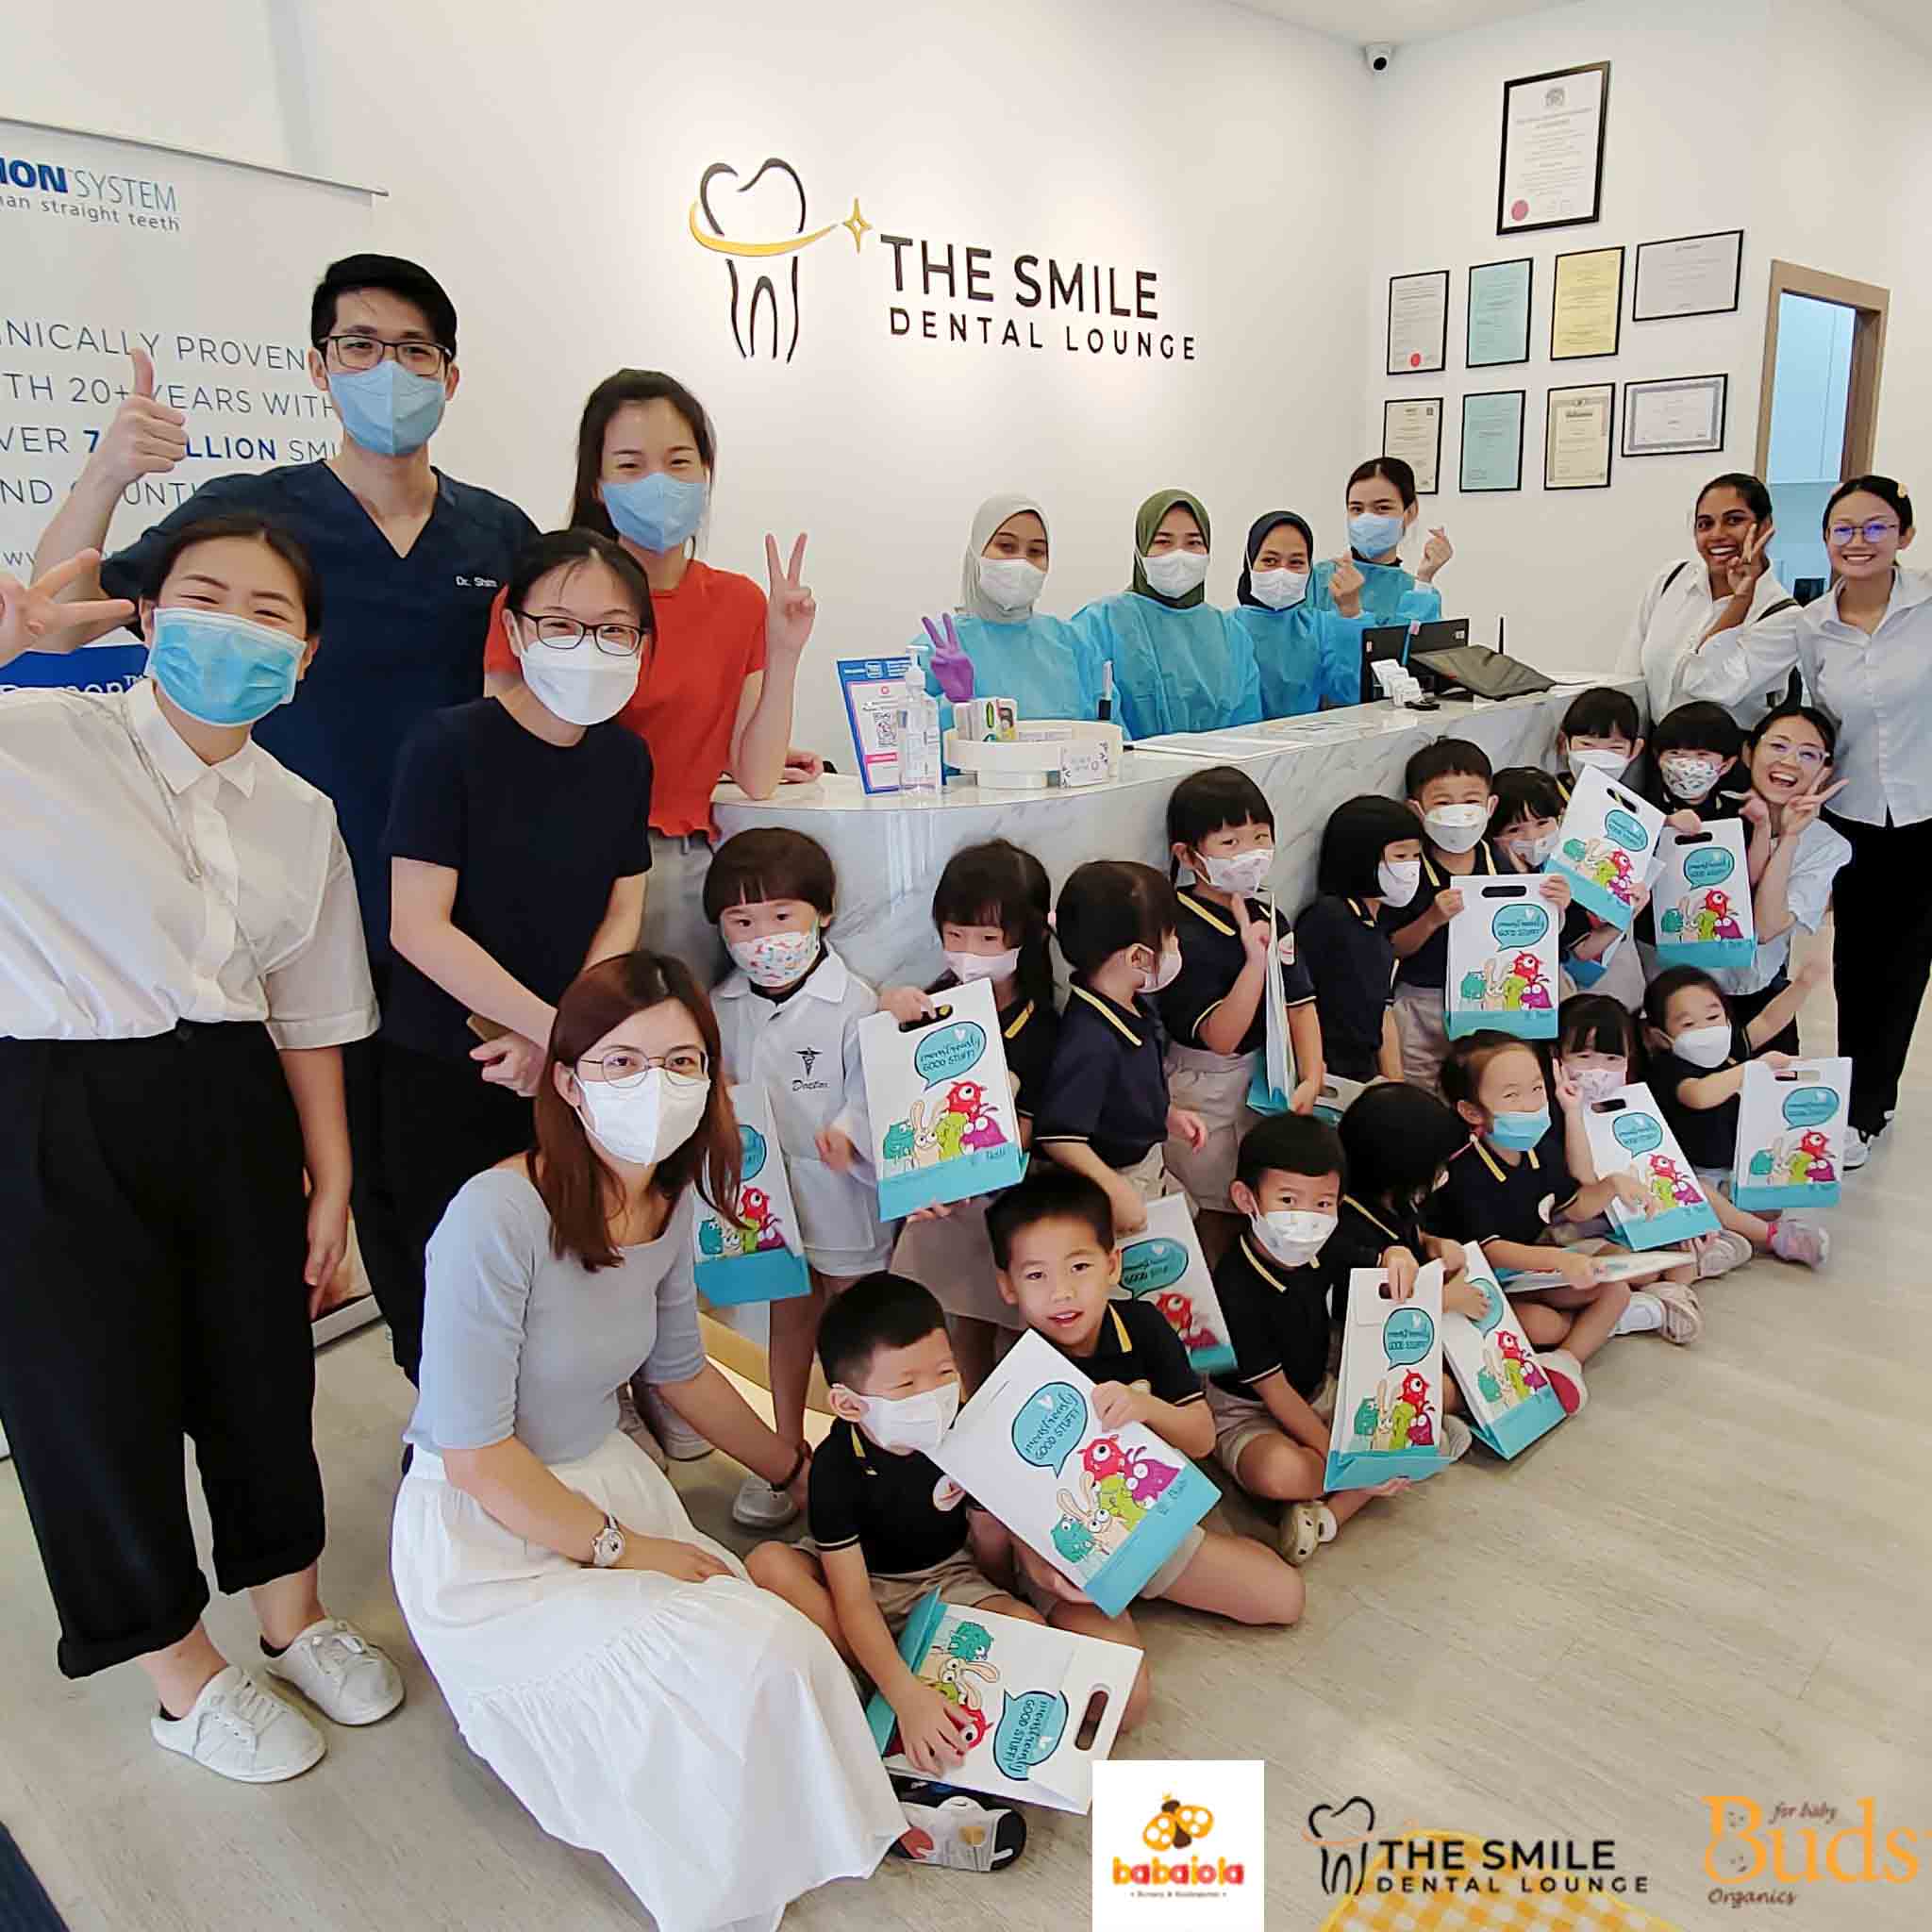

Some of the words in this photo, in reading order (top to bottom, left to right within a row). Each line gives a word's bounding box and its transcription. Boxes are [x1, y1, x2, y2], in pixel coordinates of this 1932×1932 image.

[75, 169, 177, 212] SYSTEM
[41, 200, 120, 224] straight
[128, 212, 180, 232] teeth
[880, 233, 993, 303] THE
[1014, 255, 1158, 321] SMILE
[0, 320, 158, 358] NICALLY
[176, 335, 306, 371] PROVEN
[890, 307, 1043, 349] DENTAL
[1066, 325, 1195, 360] LOUNGE
[69, 376, 129, 405] 20+
[186, 435, 277, 461] LLION
[1018, 1699, 1035, 1727] GOOD
